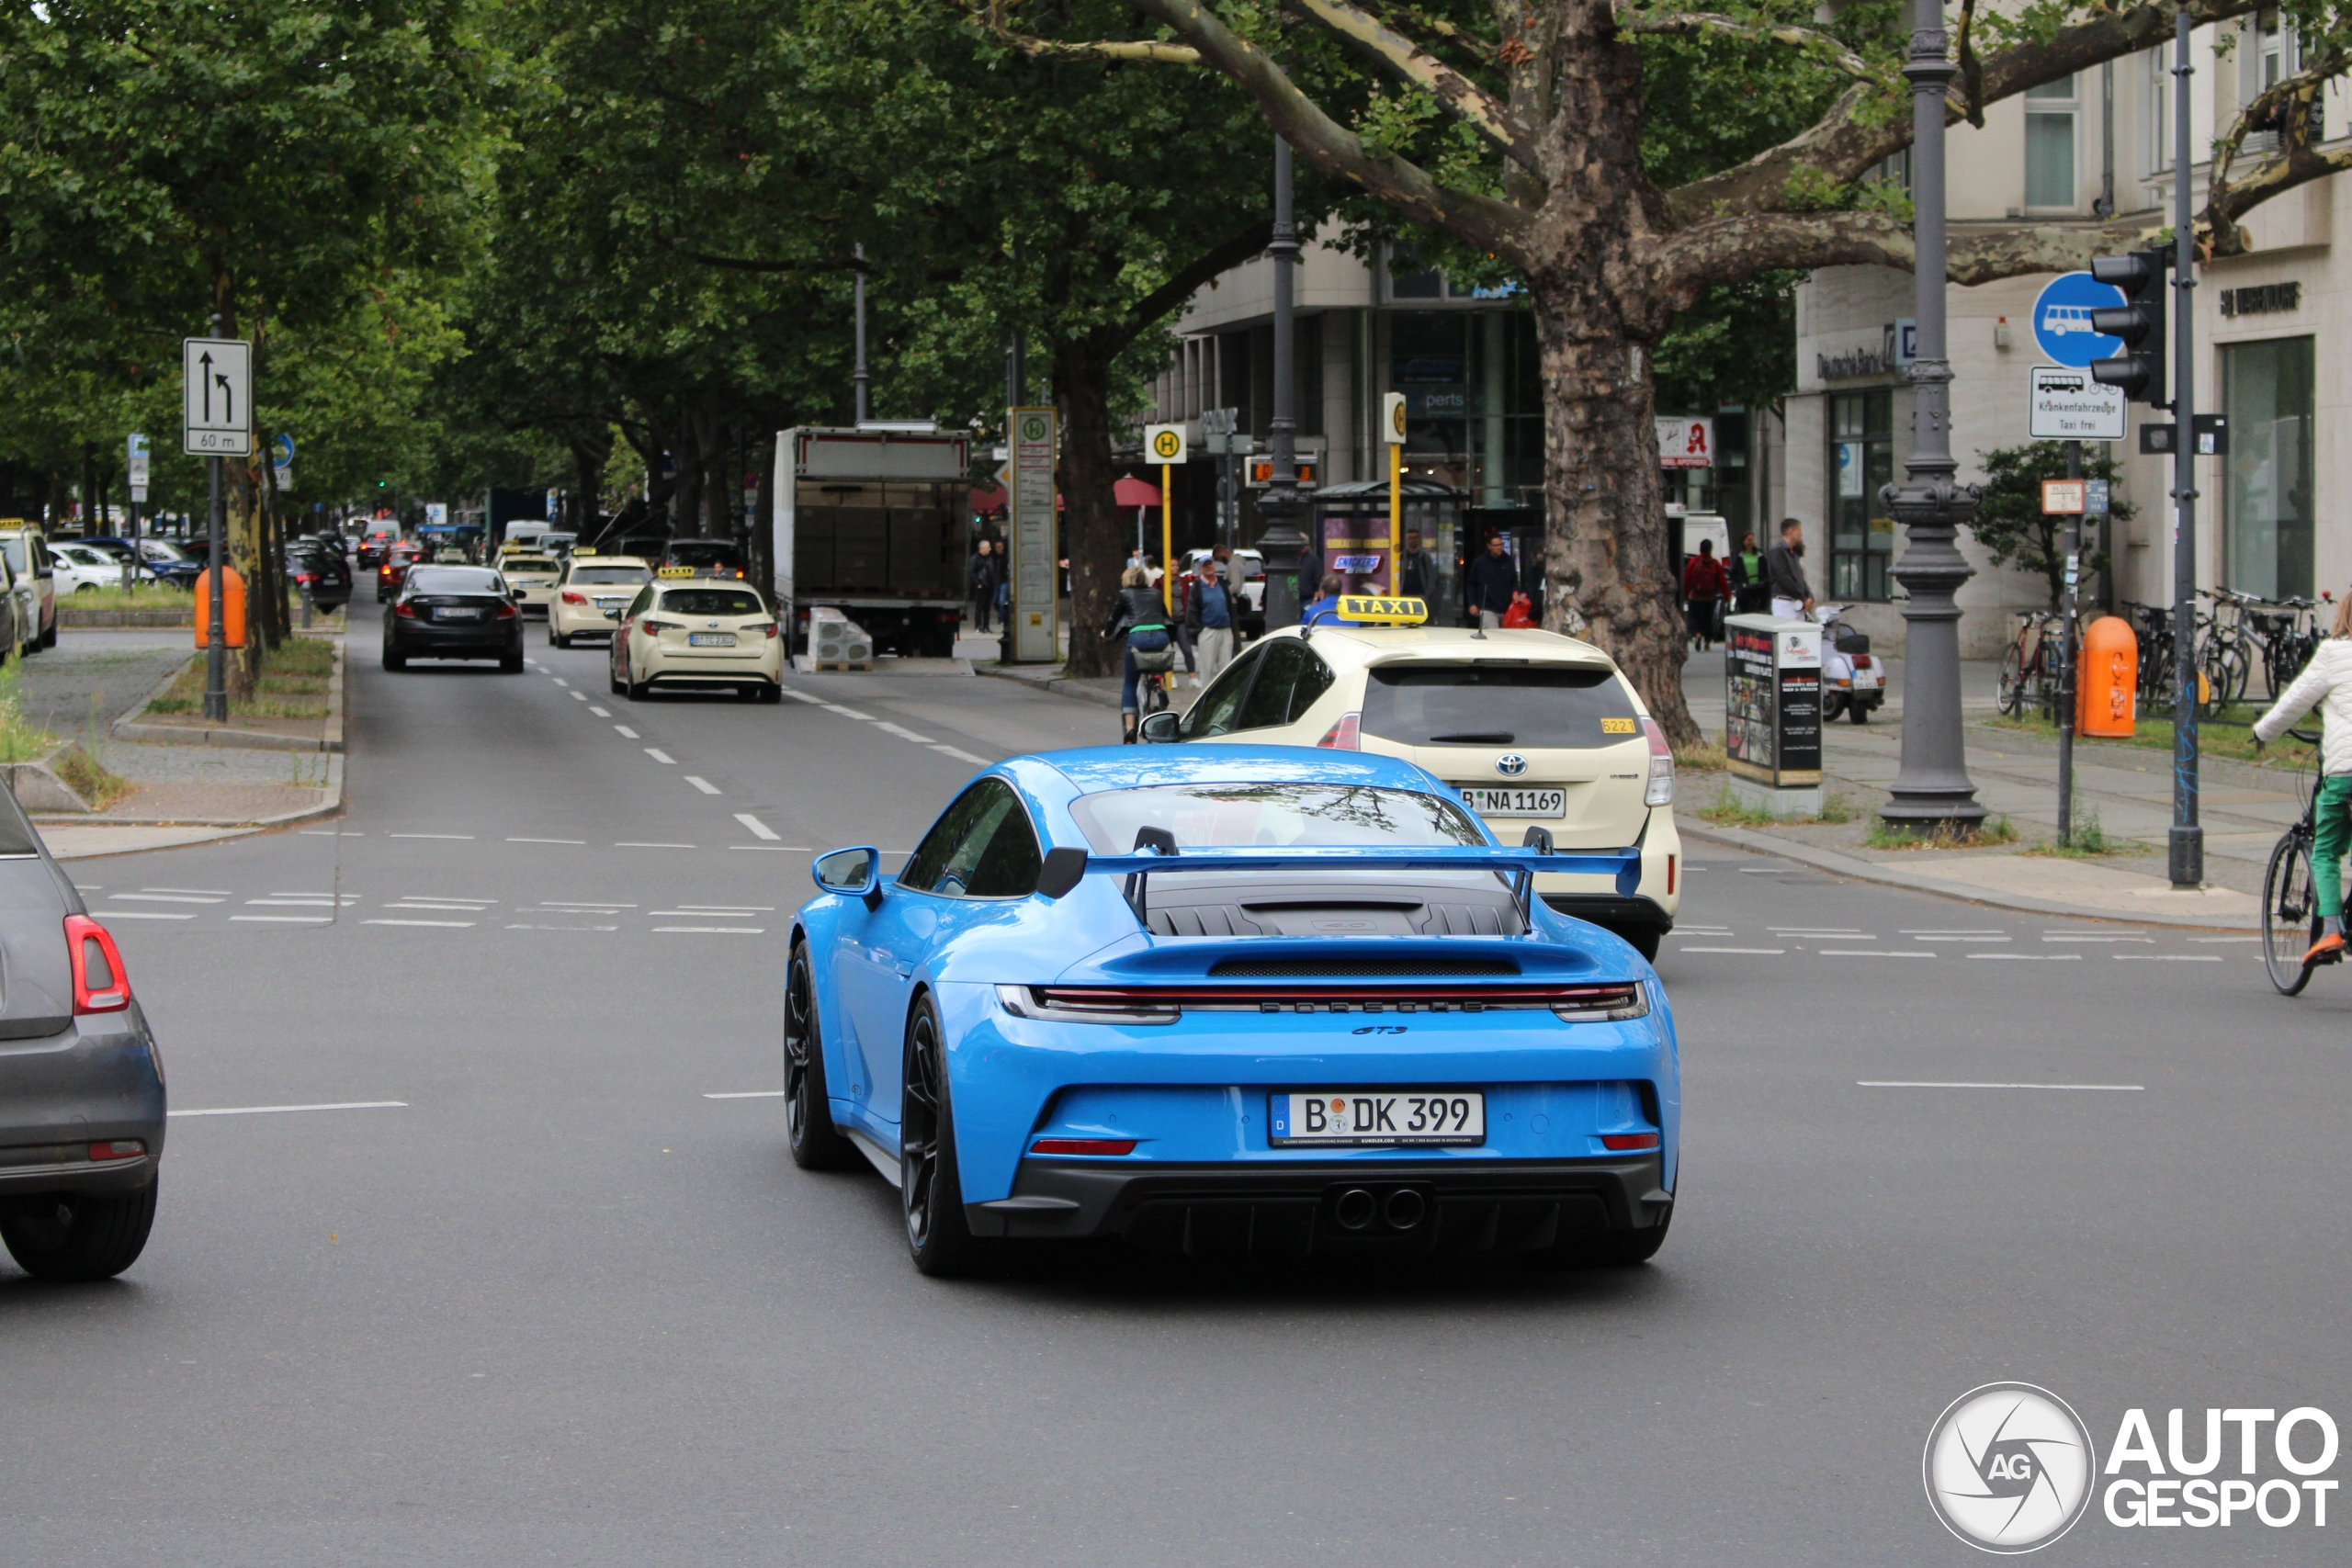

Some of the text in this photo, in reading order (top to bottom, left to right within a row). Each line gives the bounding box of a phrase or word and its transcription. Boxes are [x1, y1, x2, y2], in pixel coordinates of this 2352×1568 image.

[2039, 402, 2117, 415] Krankenfahrzeuge
[2060, 419, 2096, 430] Taxi frei
[200, 434, 234, 447] 60 m
[1161, 437, 1173, 452] H
[1336, 556, 1379, 568] SNICKERS
[1354, 600, 1415, 615] TAXI
[1602, 720, 1634, 732] 6221
[1463, 791, 1561, 811] B NA 1169
[1260, 1001, 1483, 1013] PORSCHE
[1351, 1026, 1408, 1035] GT3
[1306, 1098, 1470, 1133] B DK 399
[1276, 1120, 1284, 1131] D
